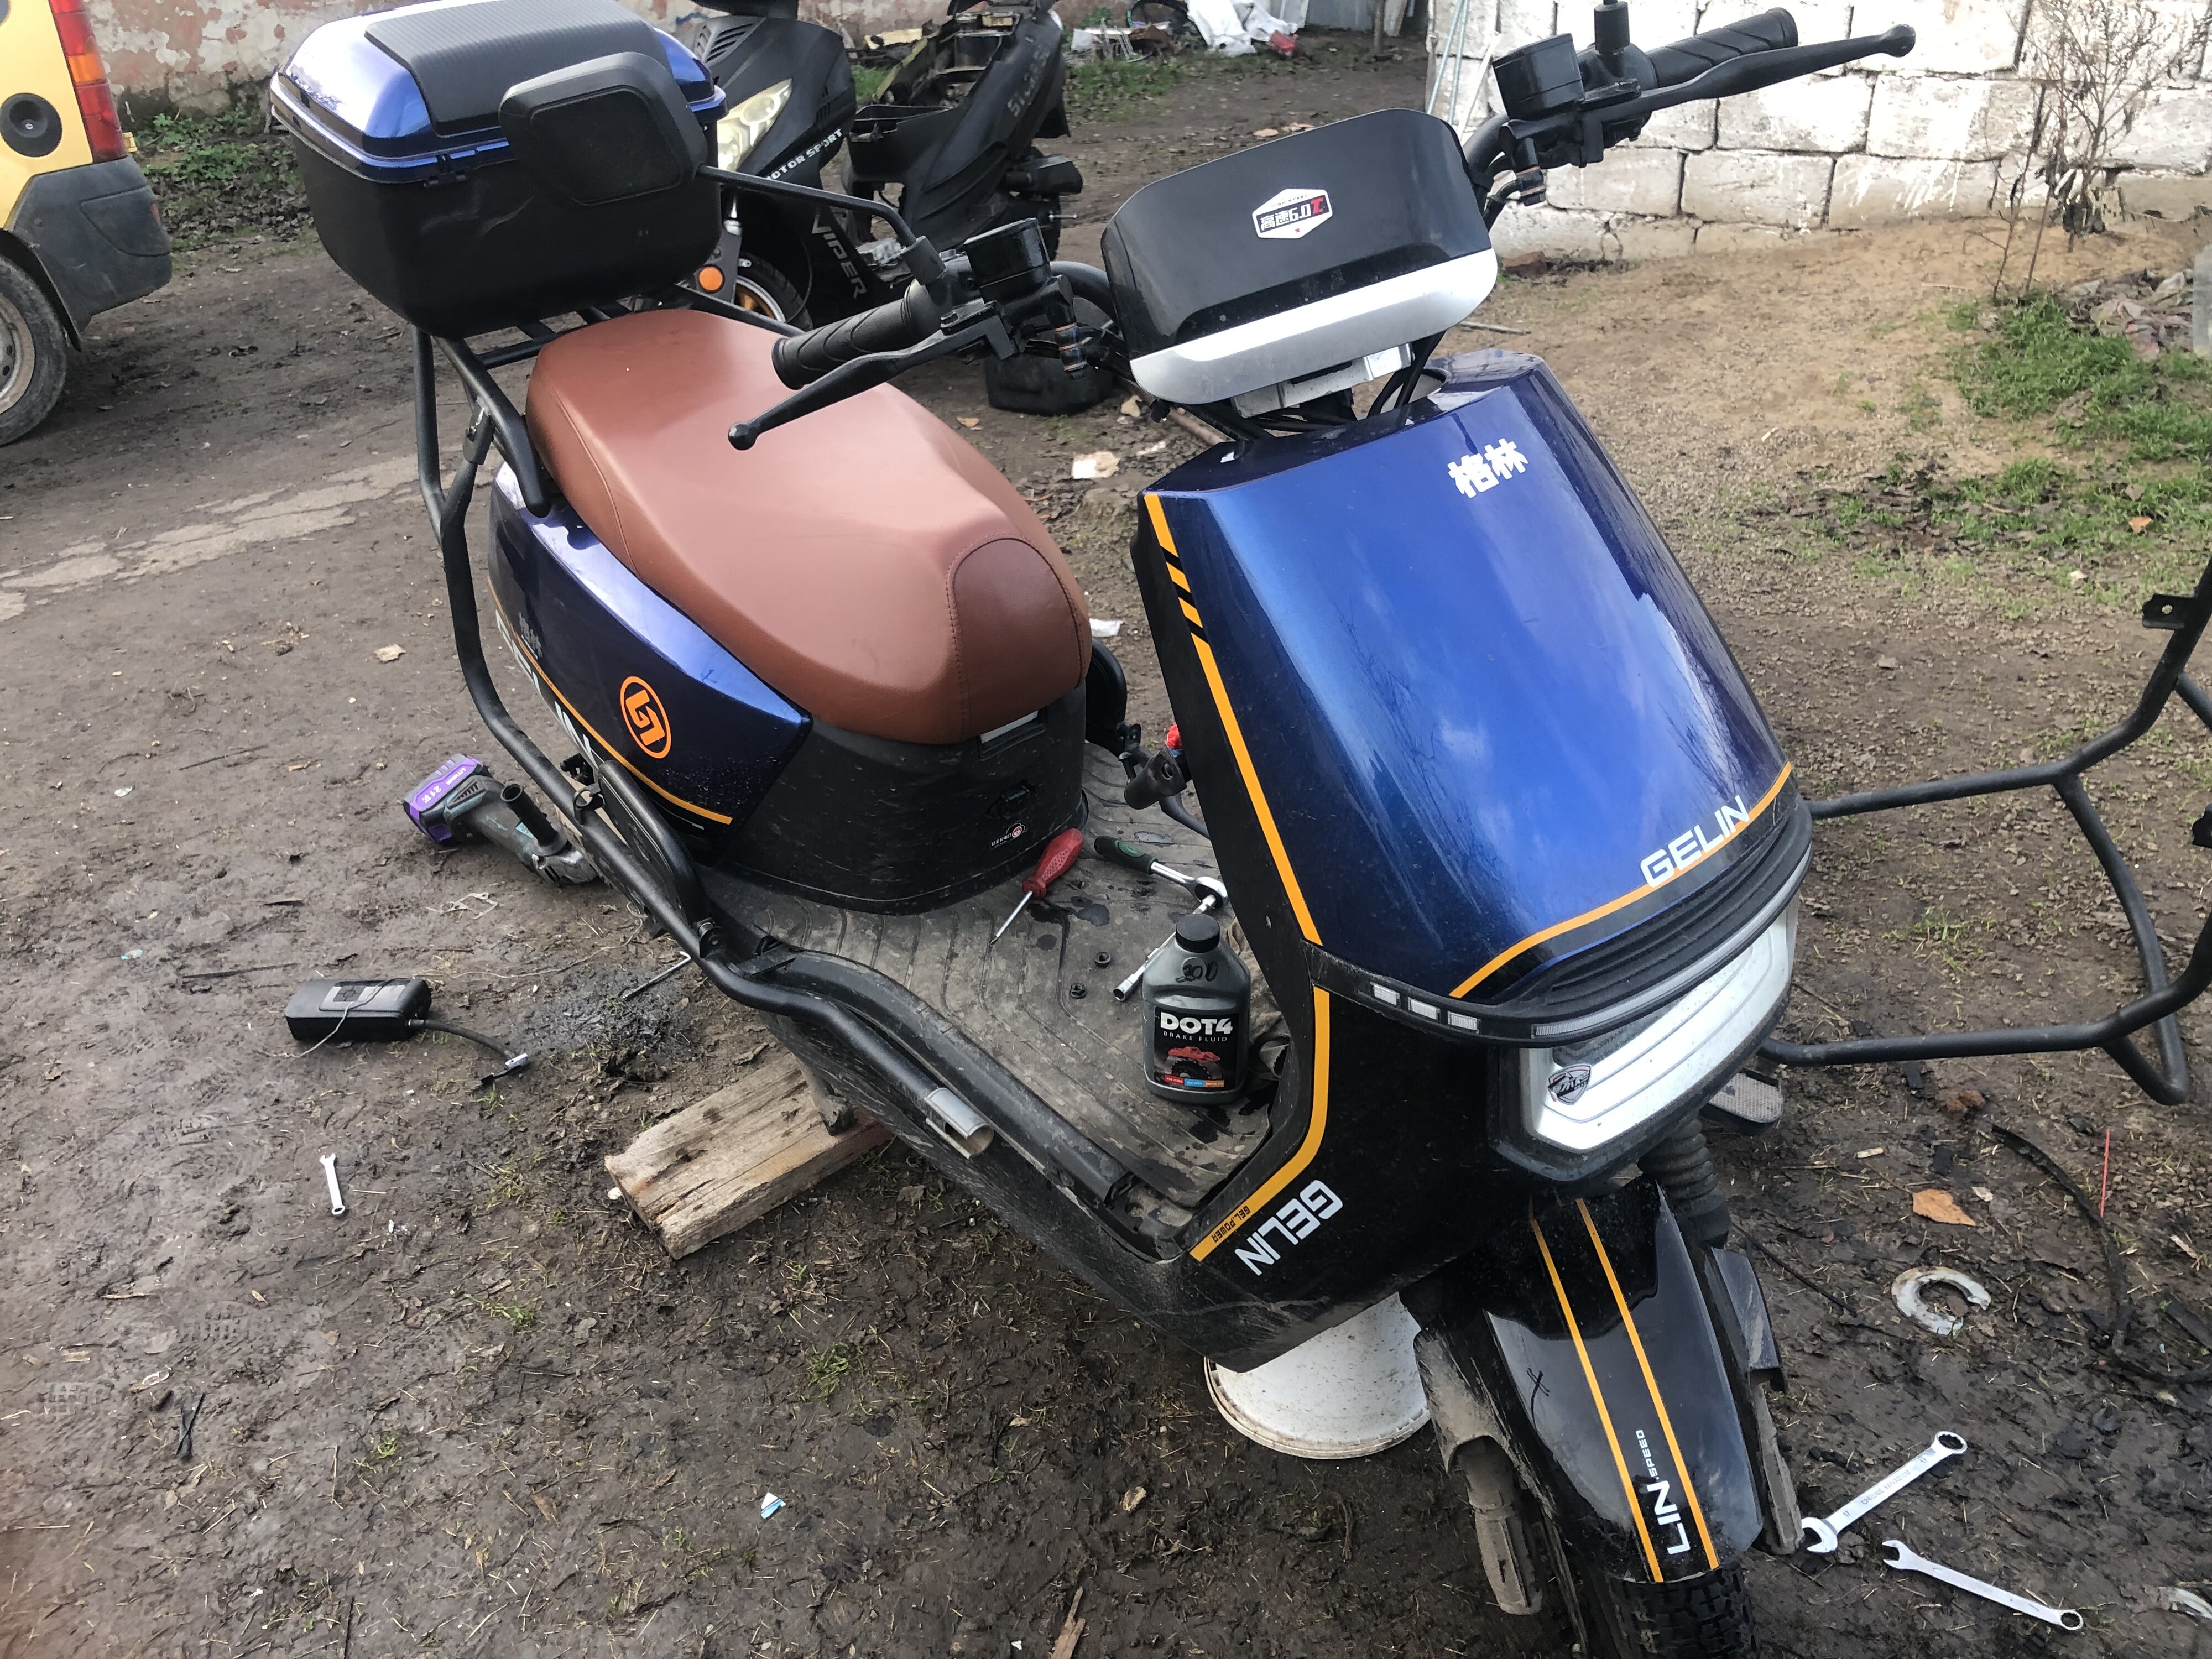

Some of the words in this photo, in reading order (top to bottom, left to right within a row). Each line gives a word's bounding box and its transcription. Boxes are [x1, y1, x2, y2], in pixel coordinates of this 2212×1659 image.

[806, 128, 842, 158] SPORT
[811, 207, 868, 299] VIPER
[1447, 437, 1528, 498] 格林
[1640, 794, 1750, 888] GELIN
[1160, 1011, 1233, 1035] DOT4
[1163, 1030, 1193, 1041] BRAKE
[1234, 1180, 1343, 1276] GELIN
[1646, 1480, 1691, 1555] LIN
